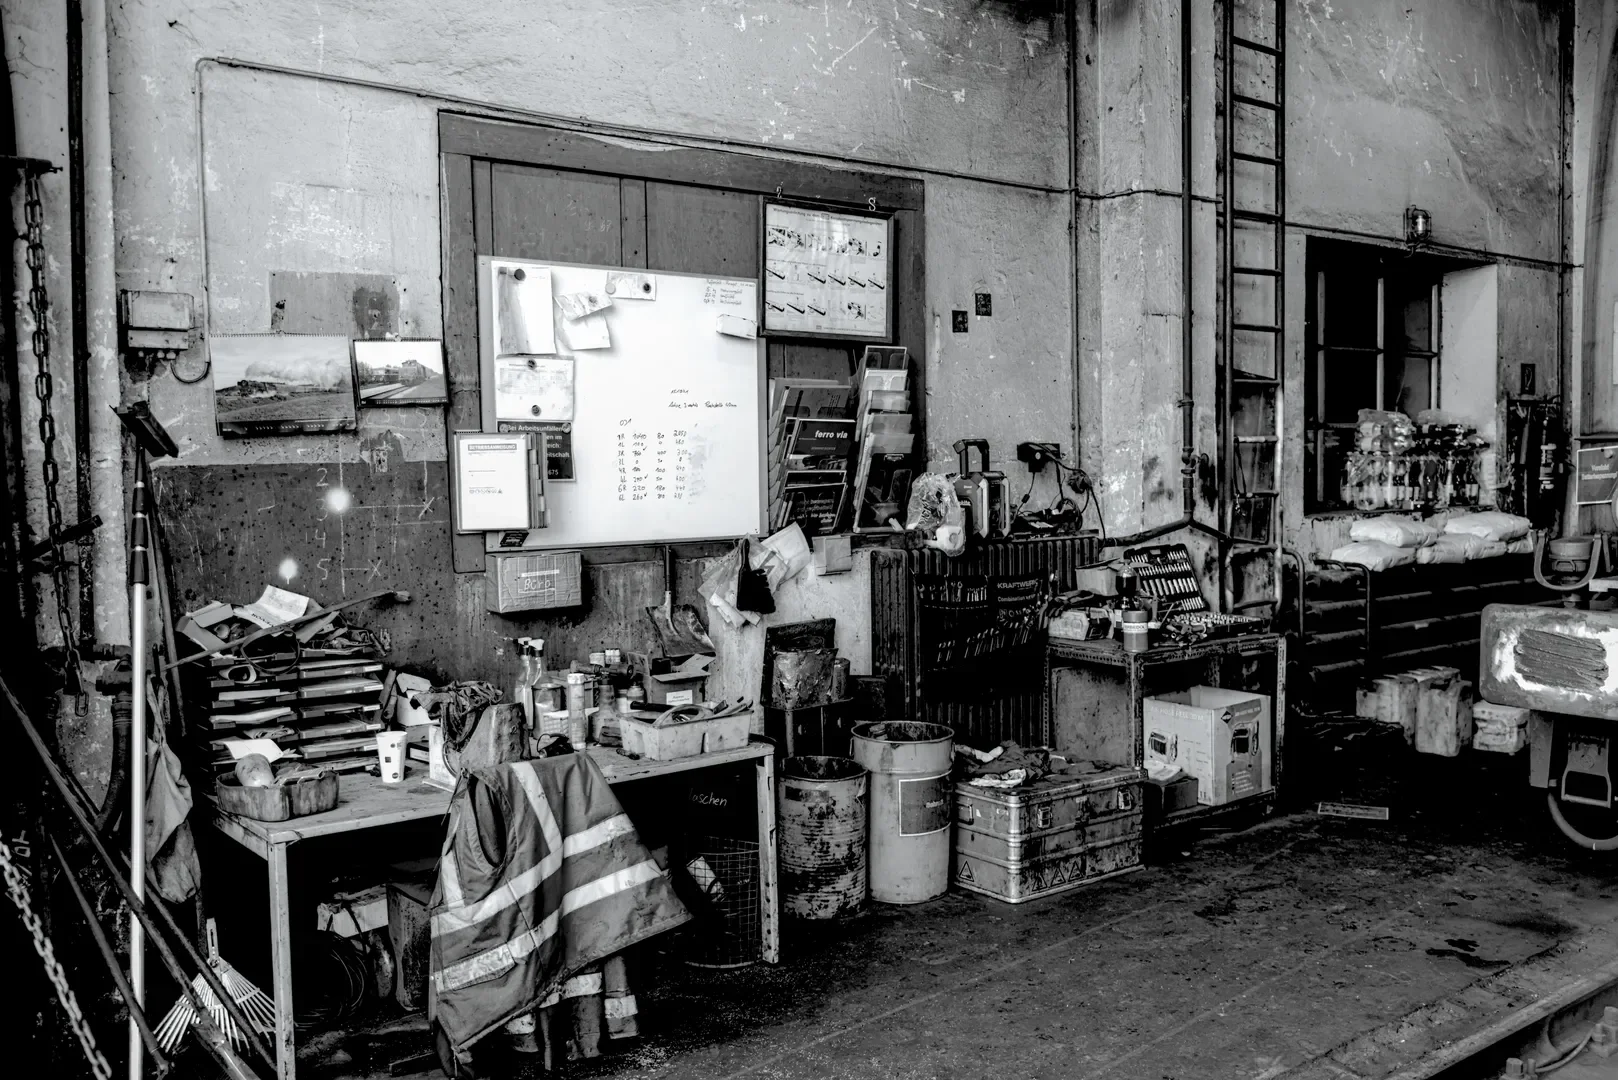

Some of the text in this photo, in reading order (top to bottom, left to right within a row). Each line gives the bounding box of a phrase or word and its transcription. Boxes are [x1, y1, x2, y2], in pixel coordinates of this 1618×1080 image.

[814, 430, 848, 439] ferro via
[316, 467, 329, 487] 2
[314, 528, 326, 549] 4
